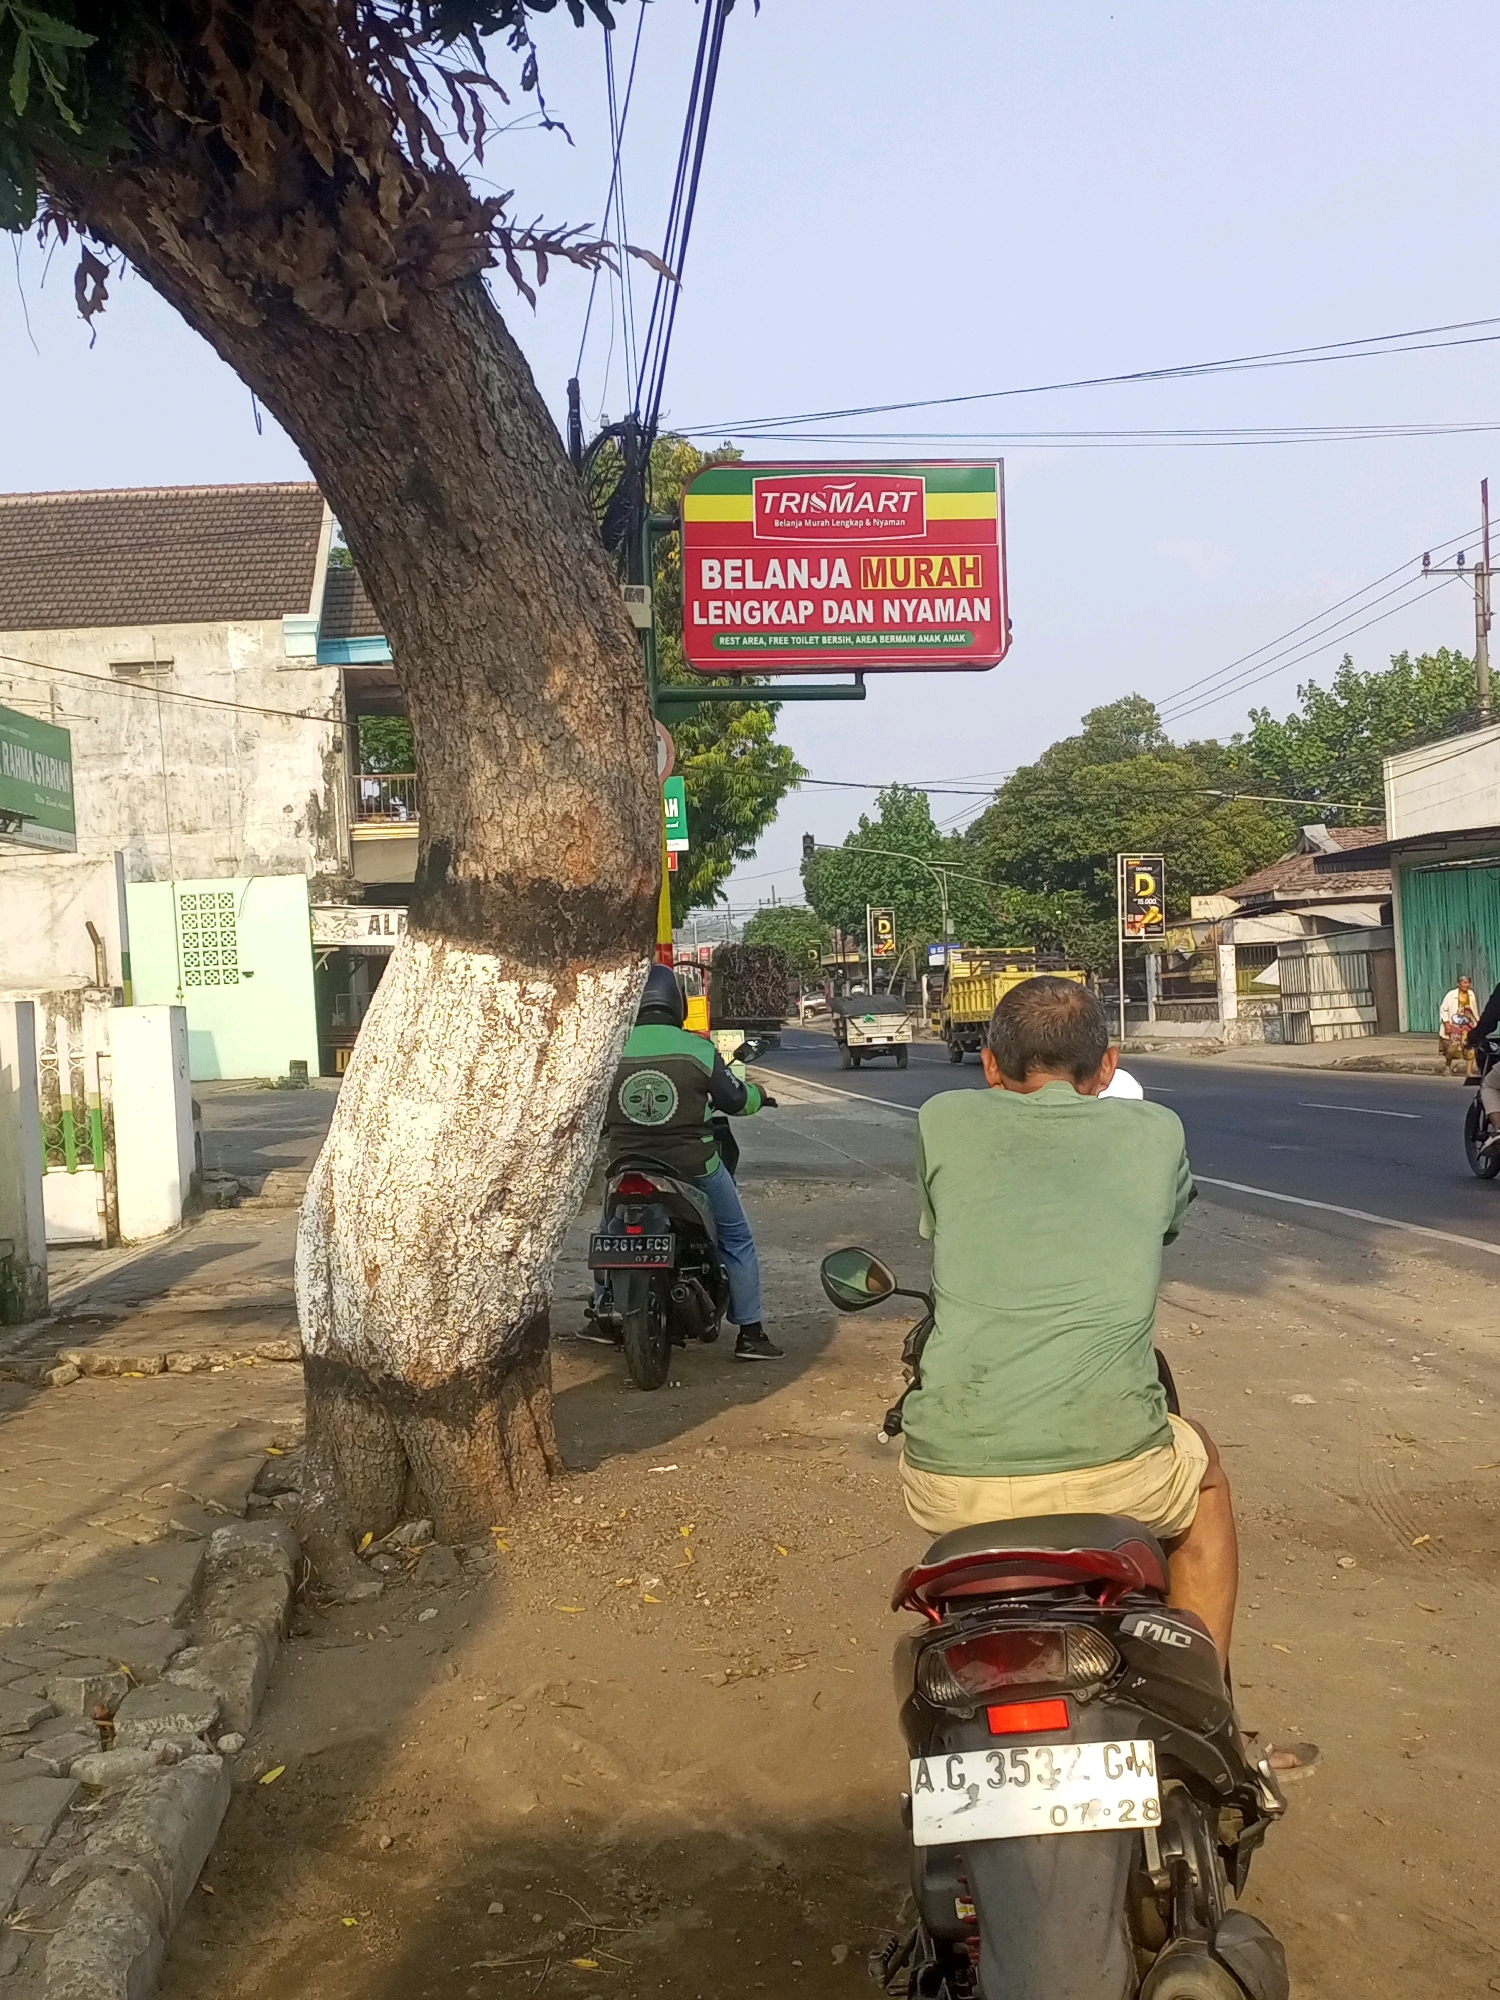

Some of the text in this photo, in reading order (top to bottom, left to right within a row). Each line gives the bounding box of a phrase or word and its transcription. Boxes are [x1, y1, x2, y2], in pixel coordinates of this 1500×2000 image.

[761, 491, 918, 514] TRISMART
[774, 517, 906, 529] Belanja Murah Lengkap & Nyaman
[701, 556, 981, 590] BELANJA MURAH
[692, 597, 991, 625] LENGKAP DAN NYAMAN
[719, 633, 966, 647] REST AREA, FREE TOILET BERSIH, AREA BERMAIN ANAK ANAK
[1, 740, 71, 794] RAHMA SYARIAH
[1134, 871, 1156, 897] D
